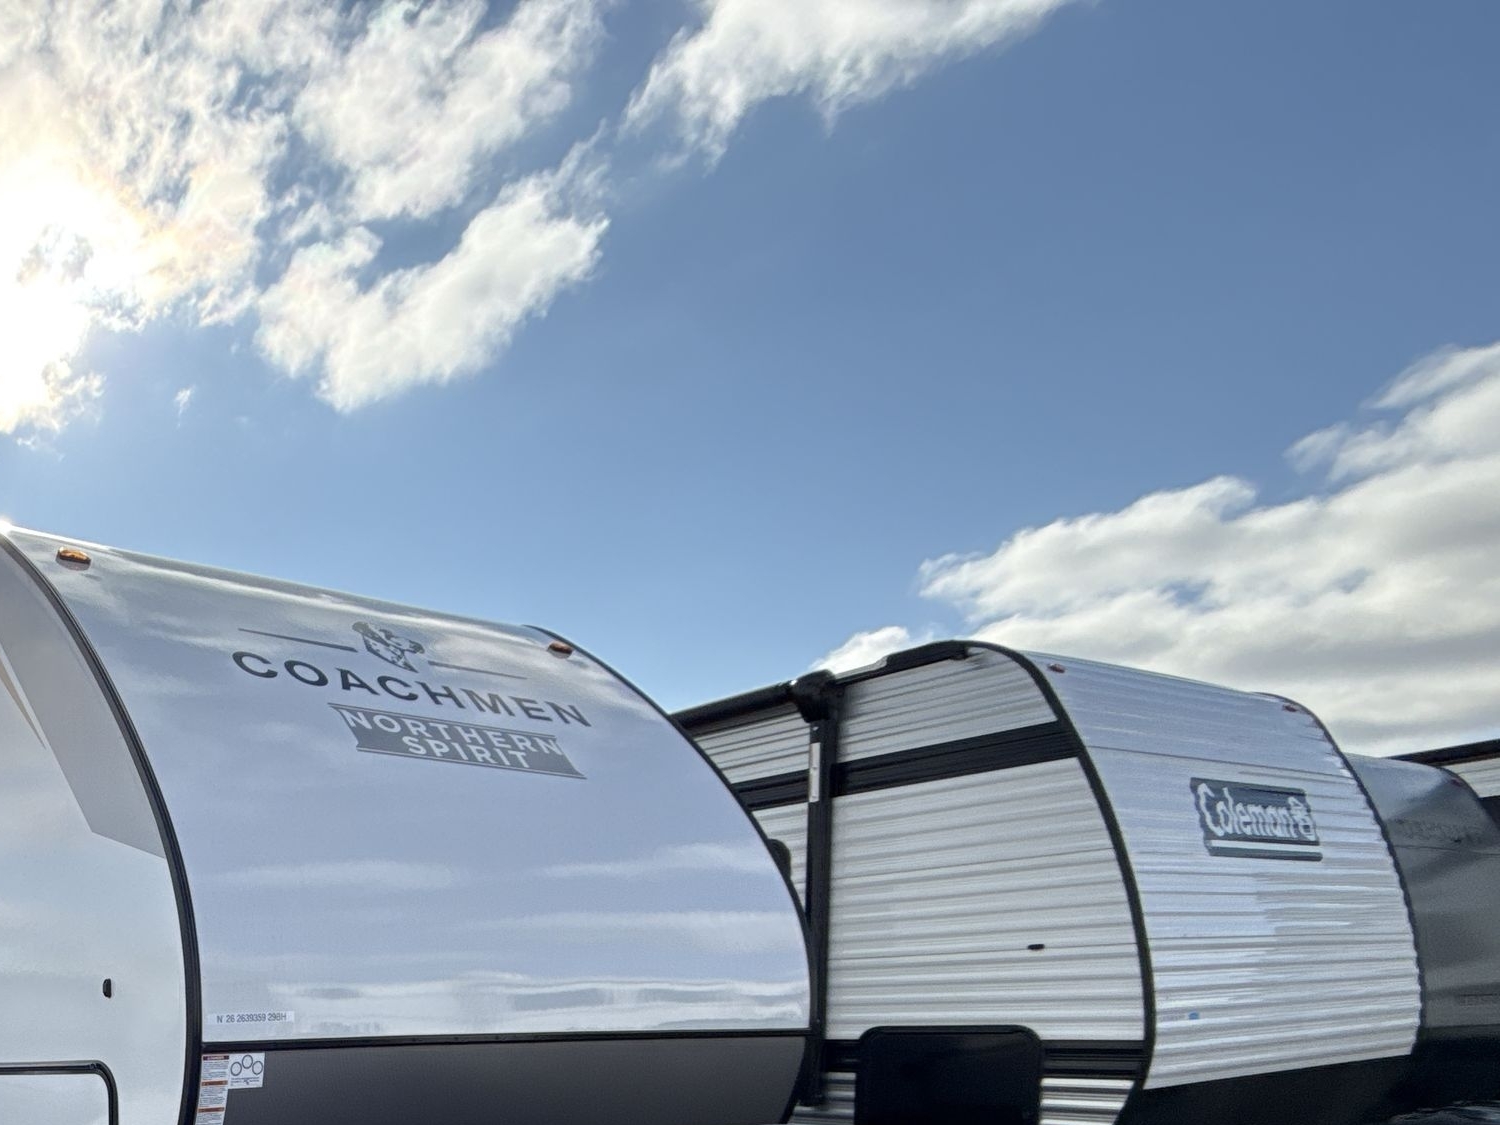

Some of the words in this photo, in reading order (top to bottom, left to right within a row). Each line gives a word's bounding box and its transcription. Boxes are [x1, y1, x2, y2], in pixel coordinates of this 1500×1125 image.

[232, 651, 592, 727] COACHMEN
[340, 709, 561, 755] NORTHERN
[401, 736, 529, 768] SPIRIT
[1198, 783, 1299, 838] Coleman
